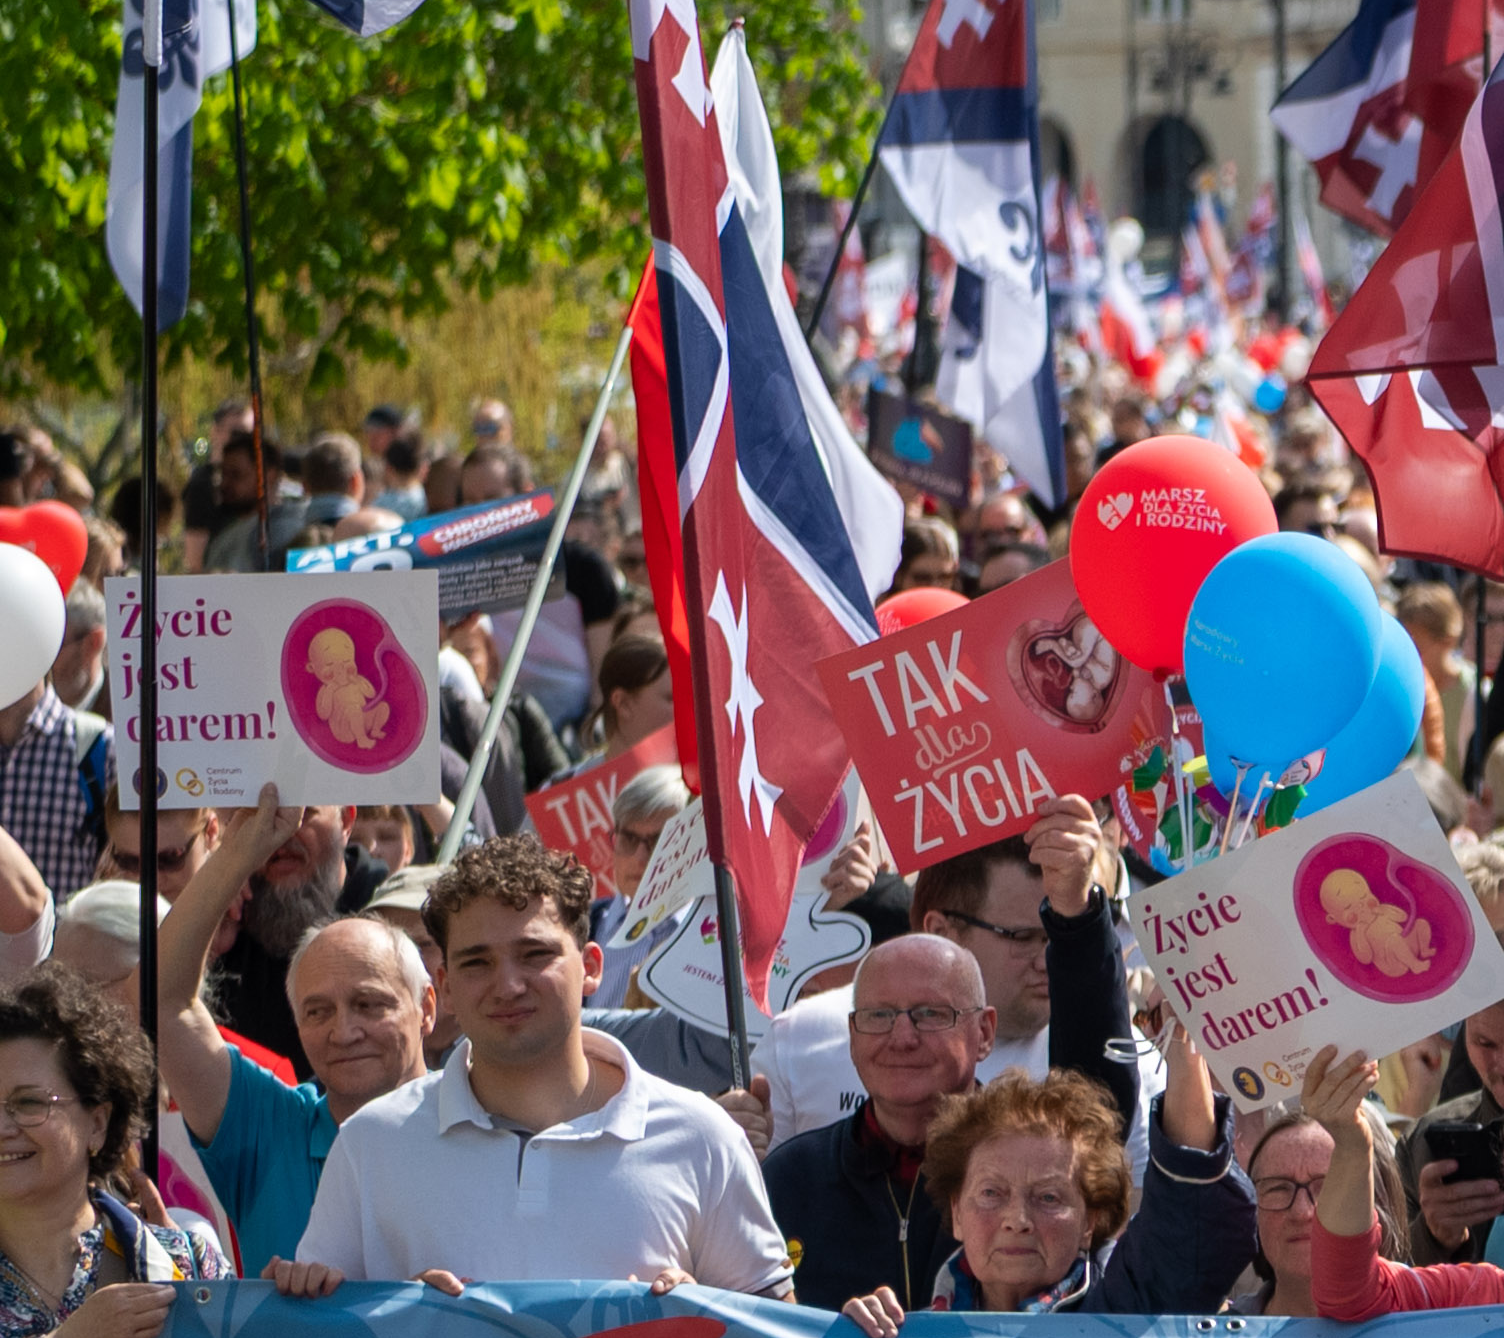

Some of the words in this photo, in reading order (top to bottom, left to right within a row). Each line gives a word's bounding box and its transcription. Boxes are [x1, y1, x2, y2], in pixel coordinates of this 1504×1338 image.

[1135, 513, 1141, 527] I
[1146, 513, 1227, 536] RODZINY
[1140, 488, 1206, 504] MARSZ
[1143, 501, 1173, 514] DLA
[121, 653, 199, 700] jst
[847, 629, 989, 737] TAK
[915, 721, 991, 780] dla
[545, 772, 617, 845] TAK
[894, 748, 1059, 854] ŻYCIA
[1144, 892, 1242, 955] Życie
[683, 964, 719, 984] JESTEM
[1166, 953, 1238, 1013] jest
[1201, 968, 1329, 1051] darem!
